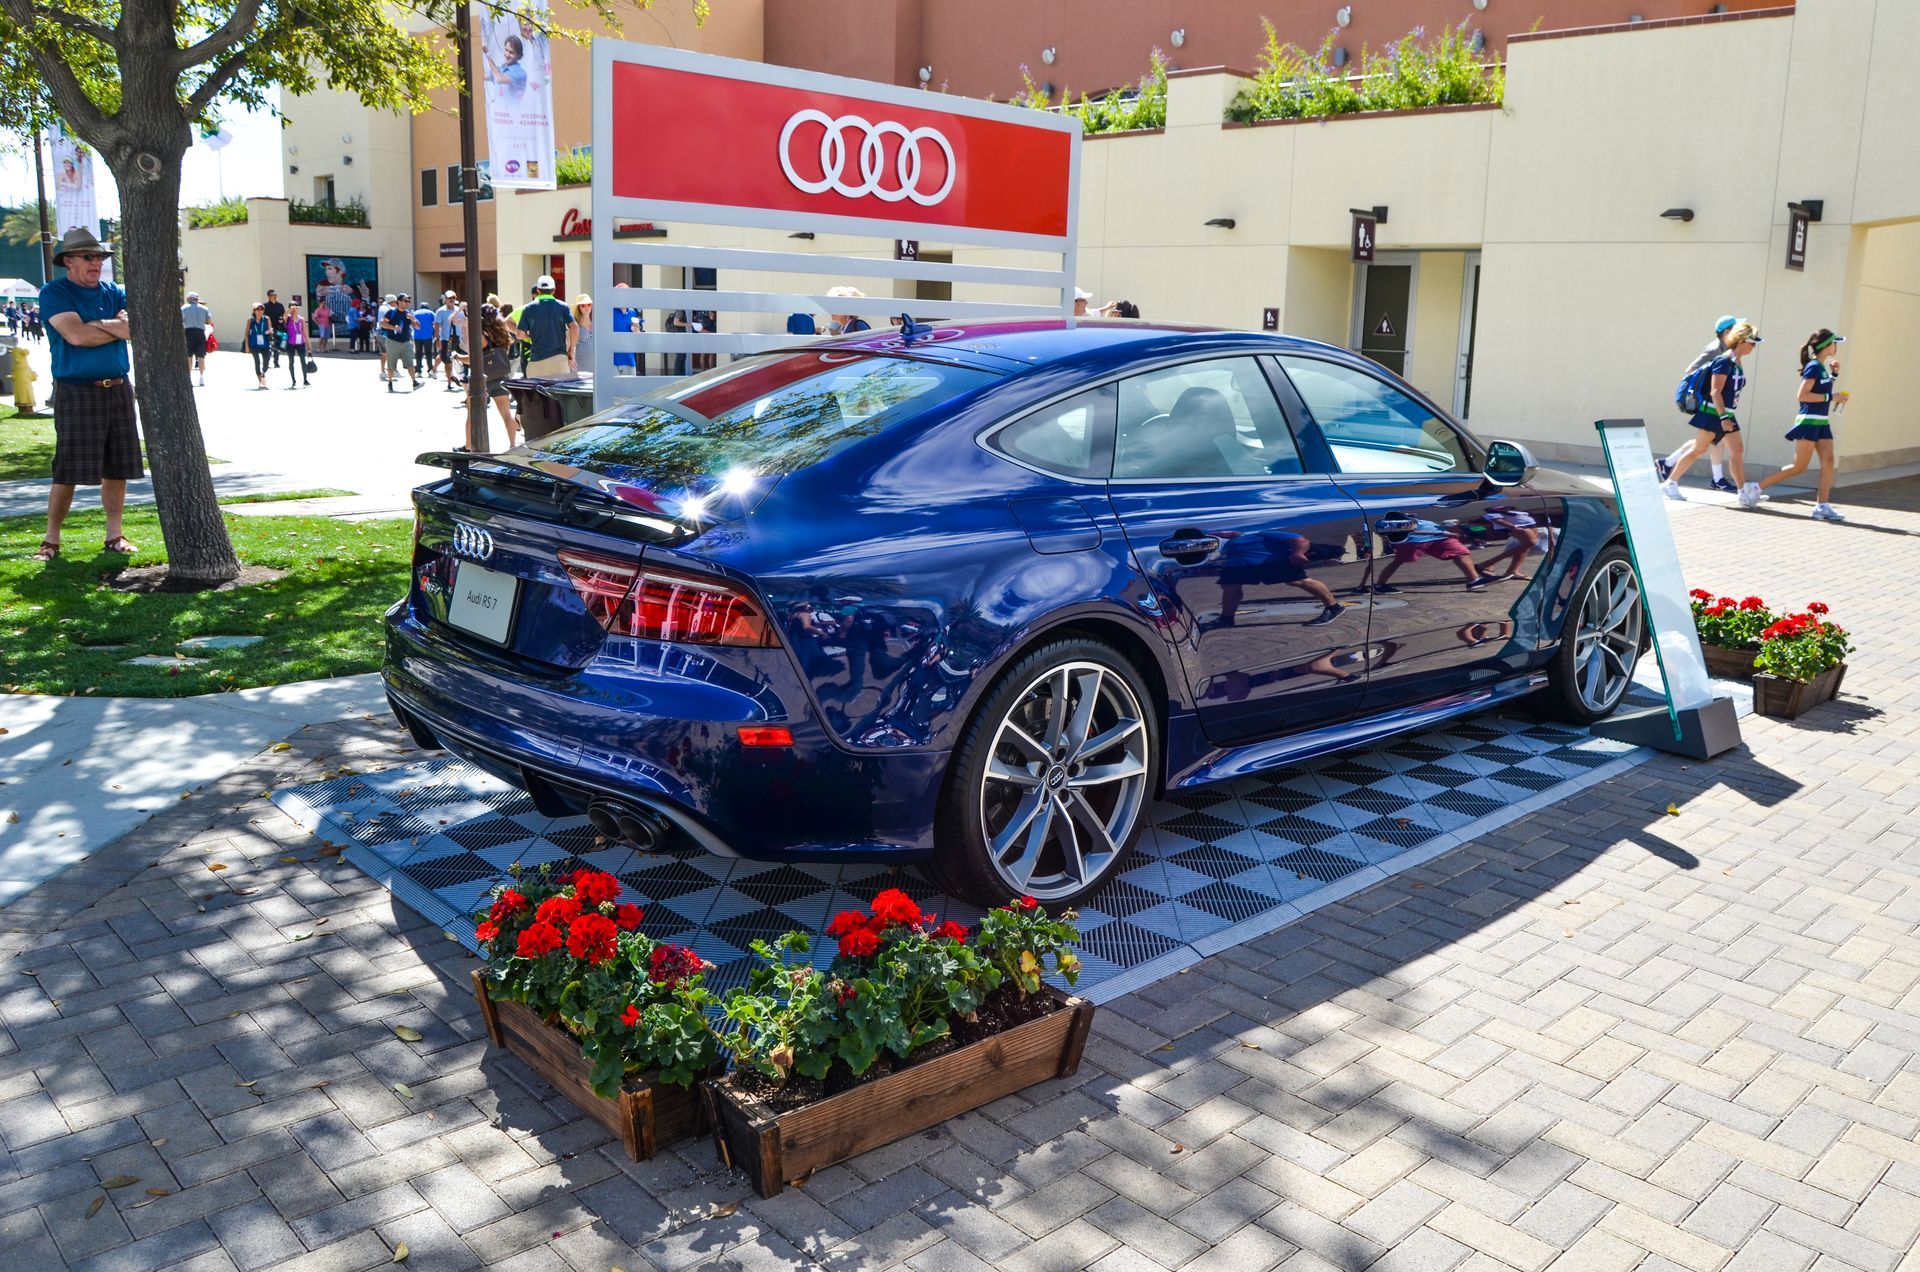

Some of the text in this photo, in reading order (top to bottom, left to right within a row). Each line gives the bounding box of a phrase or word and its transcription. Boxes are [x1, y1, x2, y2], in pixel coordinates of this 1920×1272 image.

[466, 589, 498, 610] Audi RS 7
